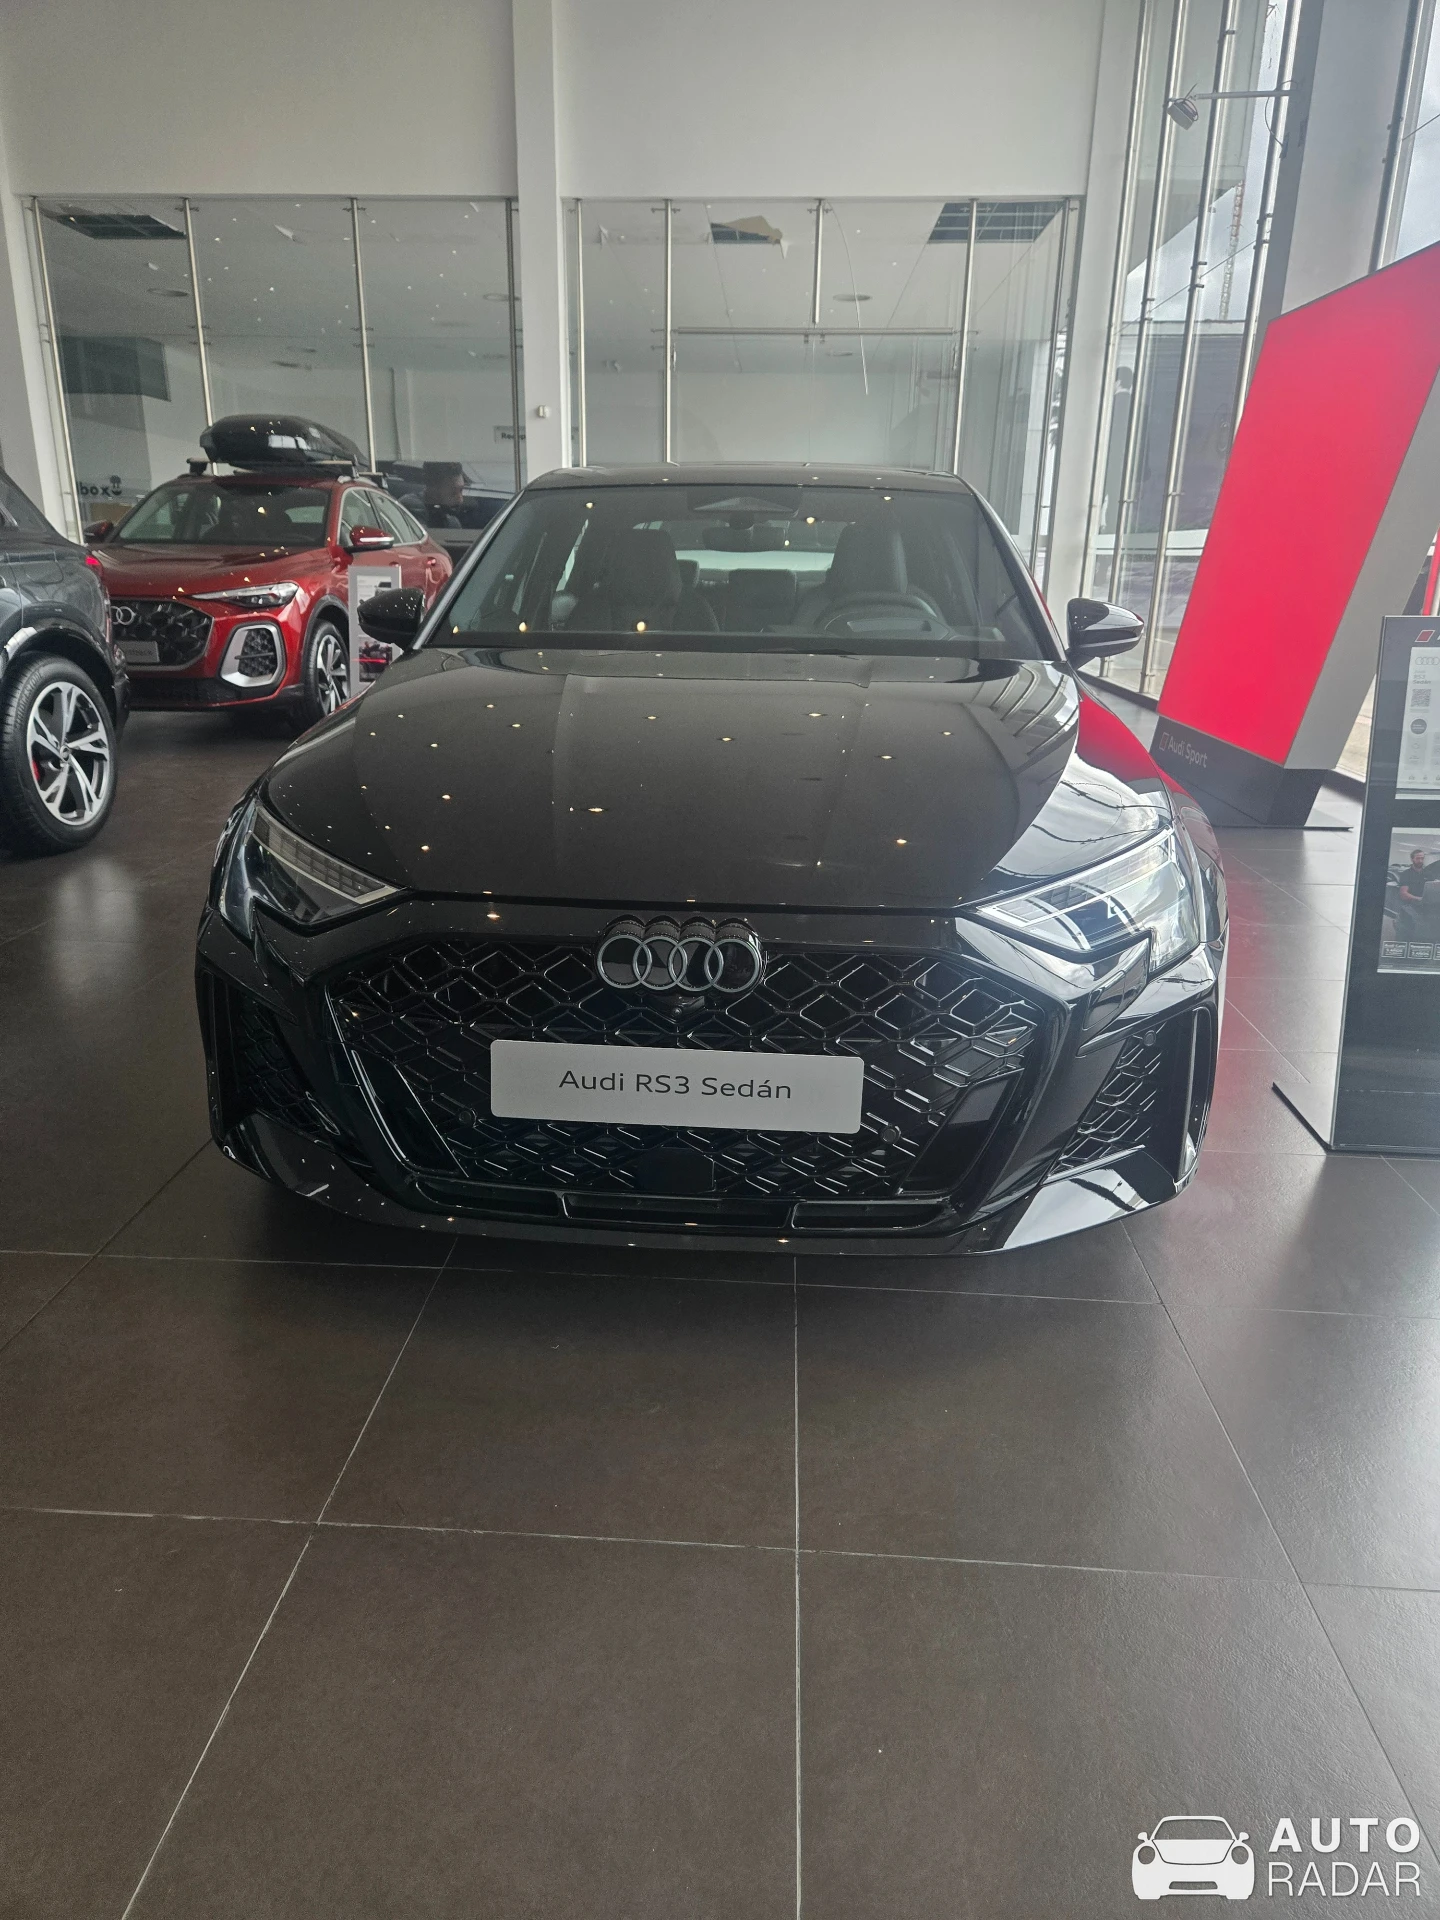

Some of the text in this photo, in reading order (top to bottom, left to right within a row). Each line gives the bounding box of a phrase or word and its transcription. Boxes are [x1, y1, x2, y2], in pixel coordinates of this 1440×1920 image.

[1167, 736, 1207, 768] Audi Sport
[559, 1070, 792, 1099] Audi RS3 Sedán
